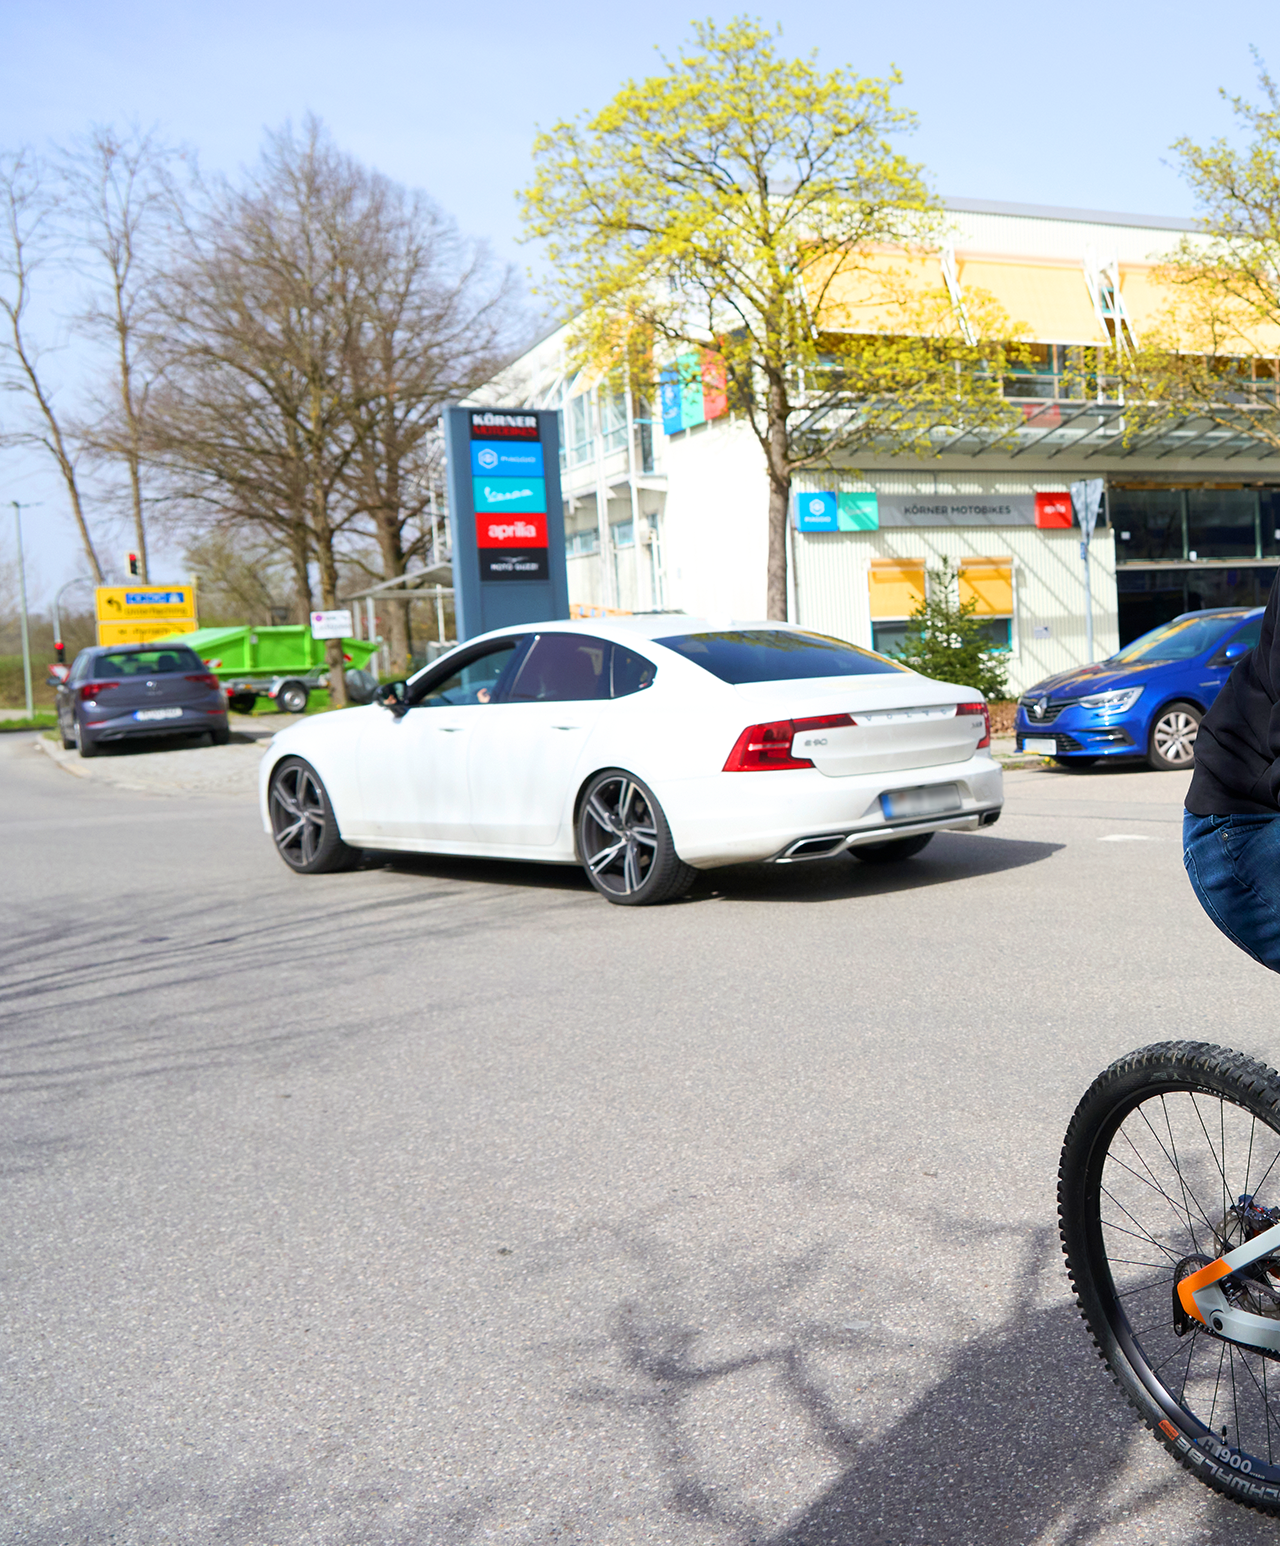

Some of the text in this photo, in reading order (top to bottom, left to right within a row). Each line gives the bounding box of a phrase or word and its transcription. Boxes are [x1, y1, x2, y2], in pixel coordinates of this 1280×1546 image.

[472, 412, 537, 428] KÖRNER
[904, 504, 1011, 515] KÖRNER MOTOBIKES
[488, 521, 537, 541] aprilia
